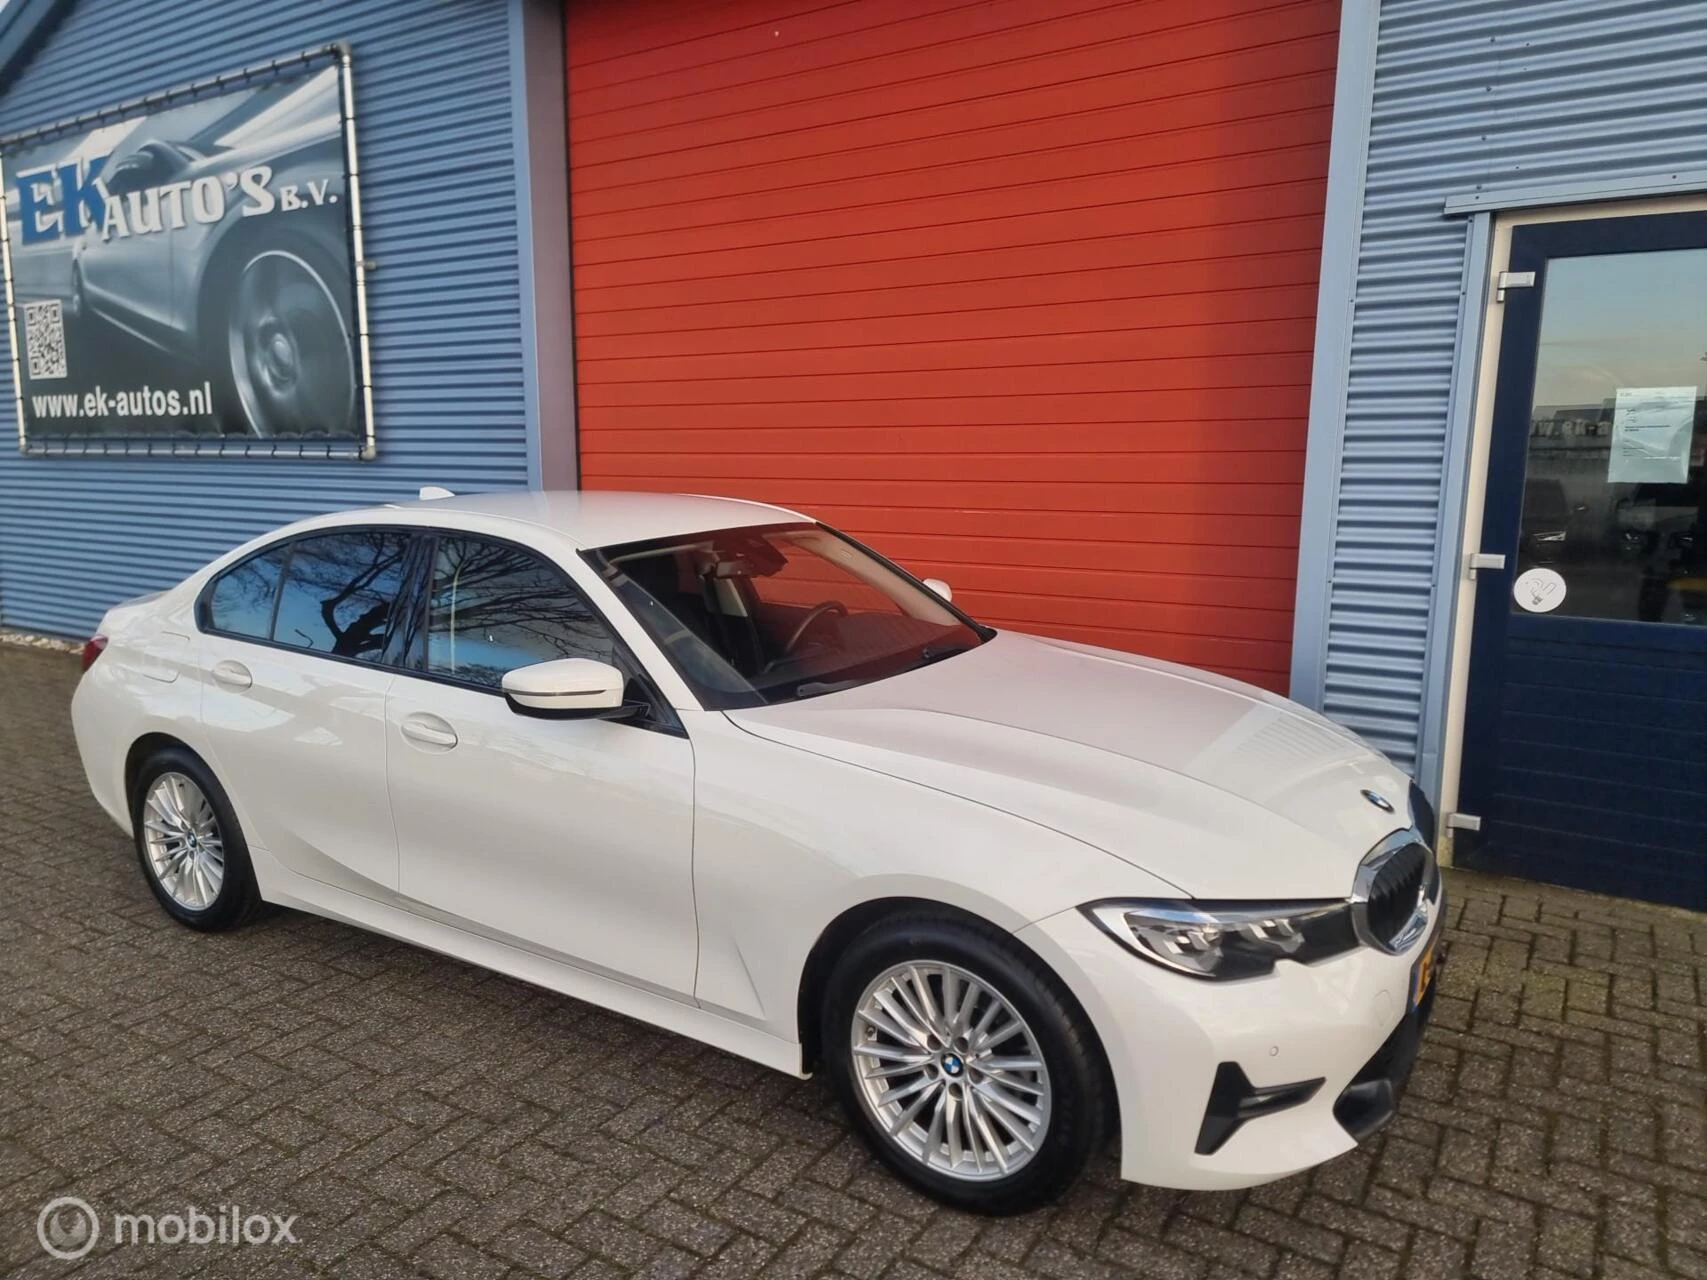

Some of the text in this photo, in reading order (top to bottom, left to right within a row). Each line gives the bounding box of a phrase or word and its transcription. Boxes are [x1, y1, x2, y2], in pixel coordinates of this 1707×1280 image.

[16, 154, 113, 245] EK
[280, 178, 338, 212] B.V.
[32, 381, 213, 418] www.ek-autos.nl
